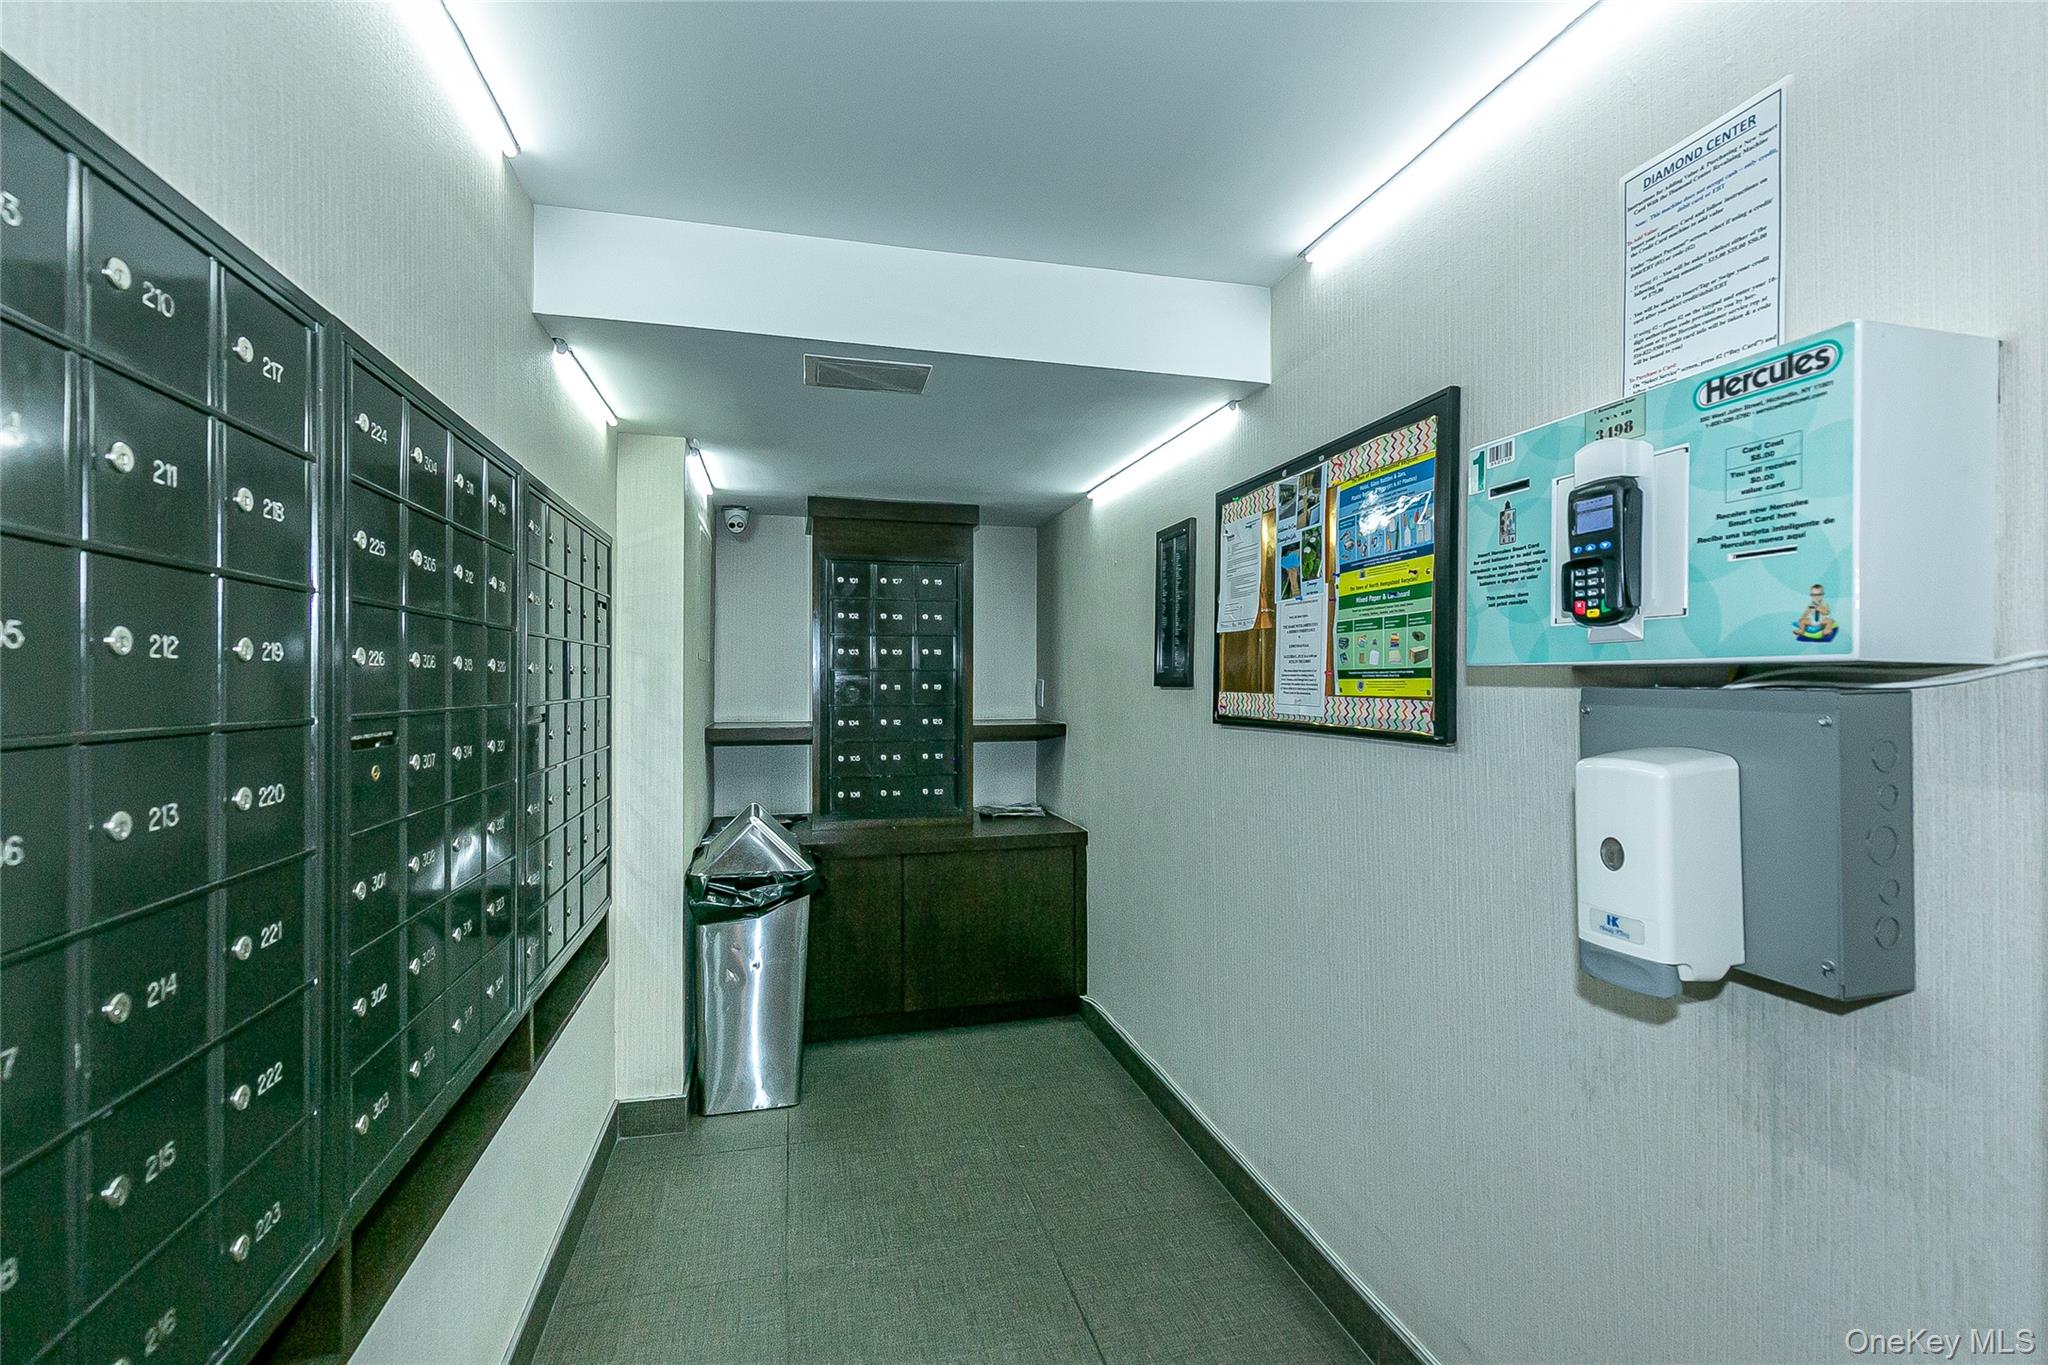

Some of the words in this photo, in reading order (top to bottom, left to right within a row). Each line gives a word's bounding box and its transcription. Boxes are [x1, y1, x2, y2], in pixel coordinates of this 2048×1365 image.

[1643, 146, 1702, 188] DIAMOND
[1706, 114, 1756, 151] CENTER
[1627, 194, 1655, 212] Instructions
[1665, 178, 1682, 190] Adding
[1684, 169, 1698, 178] Value
[1706, 146, 1737, 166] Purchasing
[1758, 123, 1777, 136] Smart
[1633, 204, 1645, 215] Card
[1646, 198, 1658, 207] With
[1668, 179, 1692, 195] Diamond
[1693, 169, 1711, 181] Center
[1743, 137, 1768, 153] Machine
[1679, 214, 1693, 225] Card
[1694, 208, 1705, 217] and
[1654, 235, 1667, 245] Card
[142, 281, 175, 318] 210
[262, 357, 283, 383] 217
[1706, 348, 1831, 403] Hercules
[371, 421, 387, 445] 224
[1742, 443, 1762, 453] Card
[1763, 438, 1784, 448] Cost
[1750, 450, 1774, 461] $5.00
[153, 460, 177, 488] 211
[1472, 450, 1484, 491] 1
[1747, 466, 1762, 474] will
[1764, 460, 1796, 471] receive
[1750, 473, 1774, 483] $0.00
[1740, 486, 1762, 494] value
[1765, 480, 1784, 490] card
[263, 498, 284, 522] 218
[1716, 510, 1747, 520] Receive
[1769, 499, 1808, 510] Hercules
[1728, 518, 1752, 527] Smart
[1754, 514, 1774, 522] Card
[1776, 511, 1796, 519] here
[1696, 535, 1723, 543] Reciba
[1771, 520, 1819, 532] inteligente
[369, 536, 386, 558] 225
[1720, 540, 1755, 549] Hercules
[150, 634, 179, 659] 212
[262, 642, 283, 662] 219
[368, 649, 386, 668] 226
[258, 784, 284, 807] 220
[148, 802, 179, 832] 213
[370, 871, 386, 891] 301
[260, 921, 282, 949] 221
[147, 972, 177, 1010] 214
[370, 982, 388, 1007] 302
[257, 1062, 283, 1098] 222
[372, 1091, 390, 1119] 303
[145, 1140, 177, 1184] 215
[255, 1201, 281, 1242] 223
